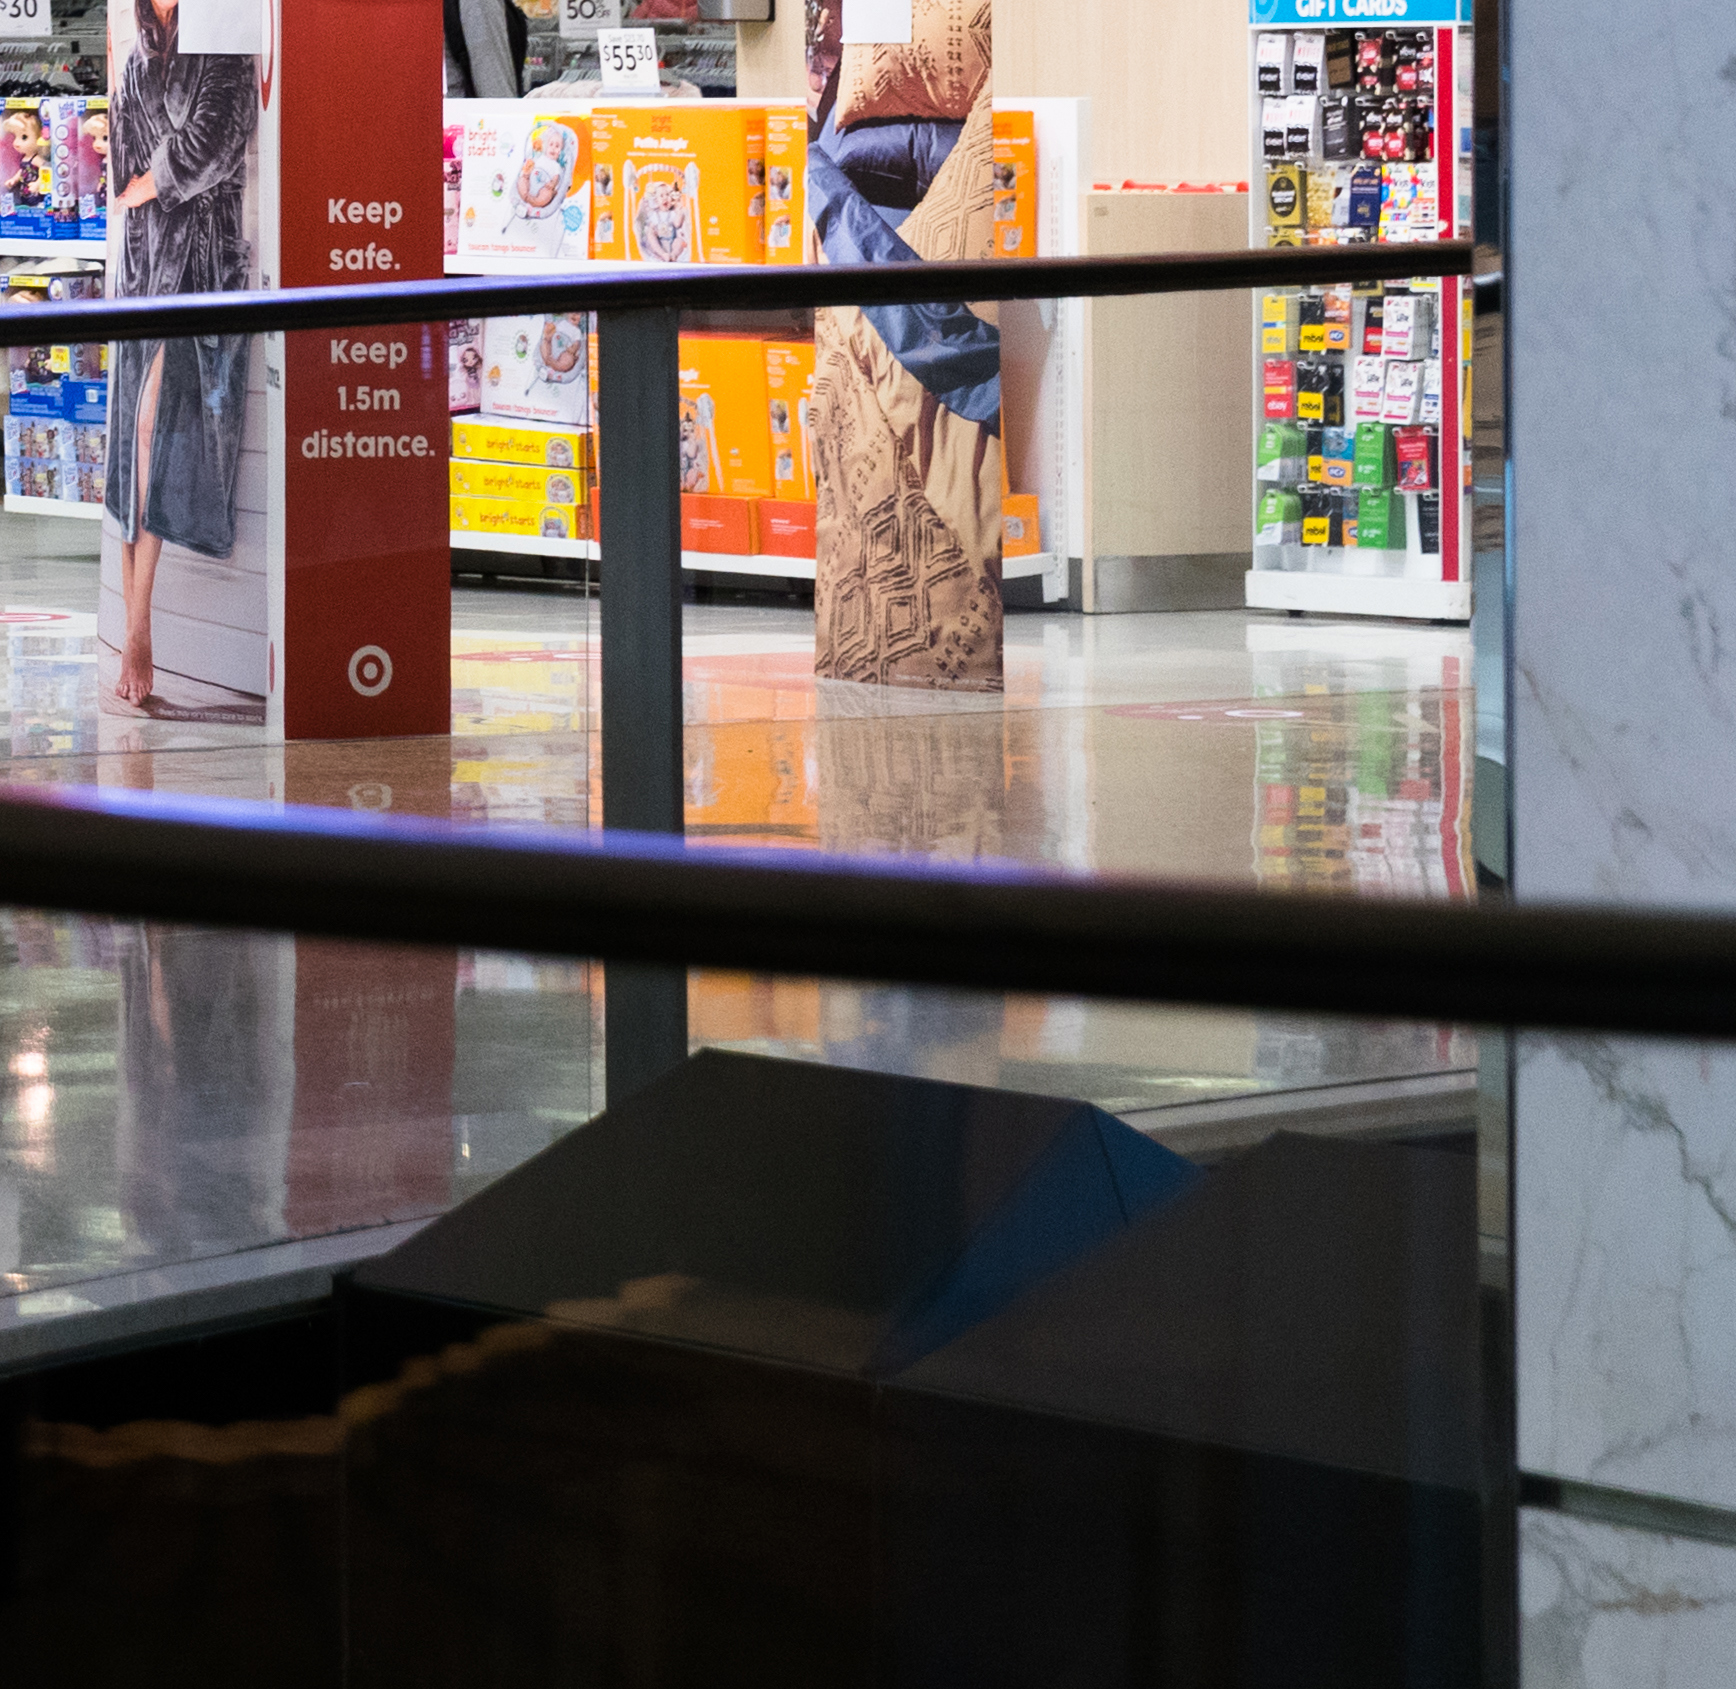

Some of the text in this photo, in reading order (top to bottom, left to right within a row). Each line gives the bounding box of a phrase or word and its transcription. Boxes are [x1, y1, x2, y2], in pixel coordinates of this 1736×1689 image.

[468, 129, 498, 145] bright
[467, 144, 497, 157] starts
[328, 198, 404, 229] Keep
[329, 243, 401, 271] safe.
[330, 339, 409, 370] Keep
[337, 386, 401, 411] 1.5m
[1301, 401, 1321, 411] rebel
[301, 428, 436, 459] distance.
[486, 440, 509, 453] bright
[484, 476, 509, 490] bright
[479, 513, 504, 526] bright
